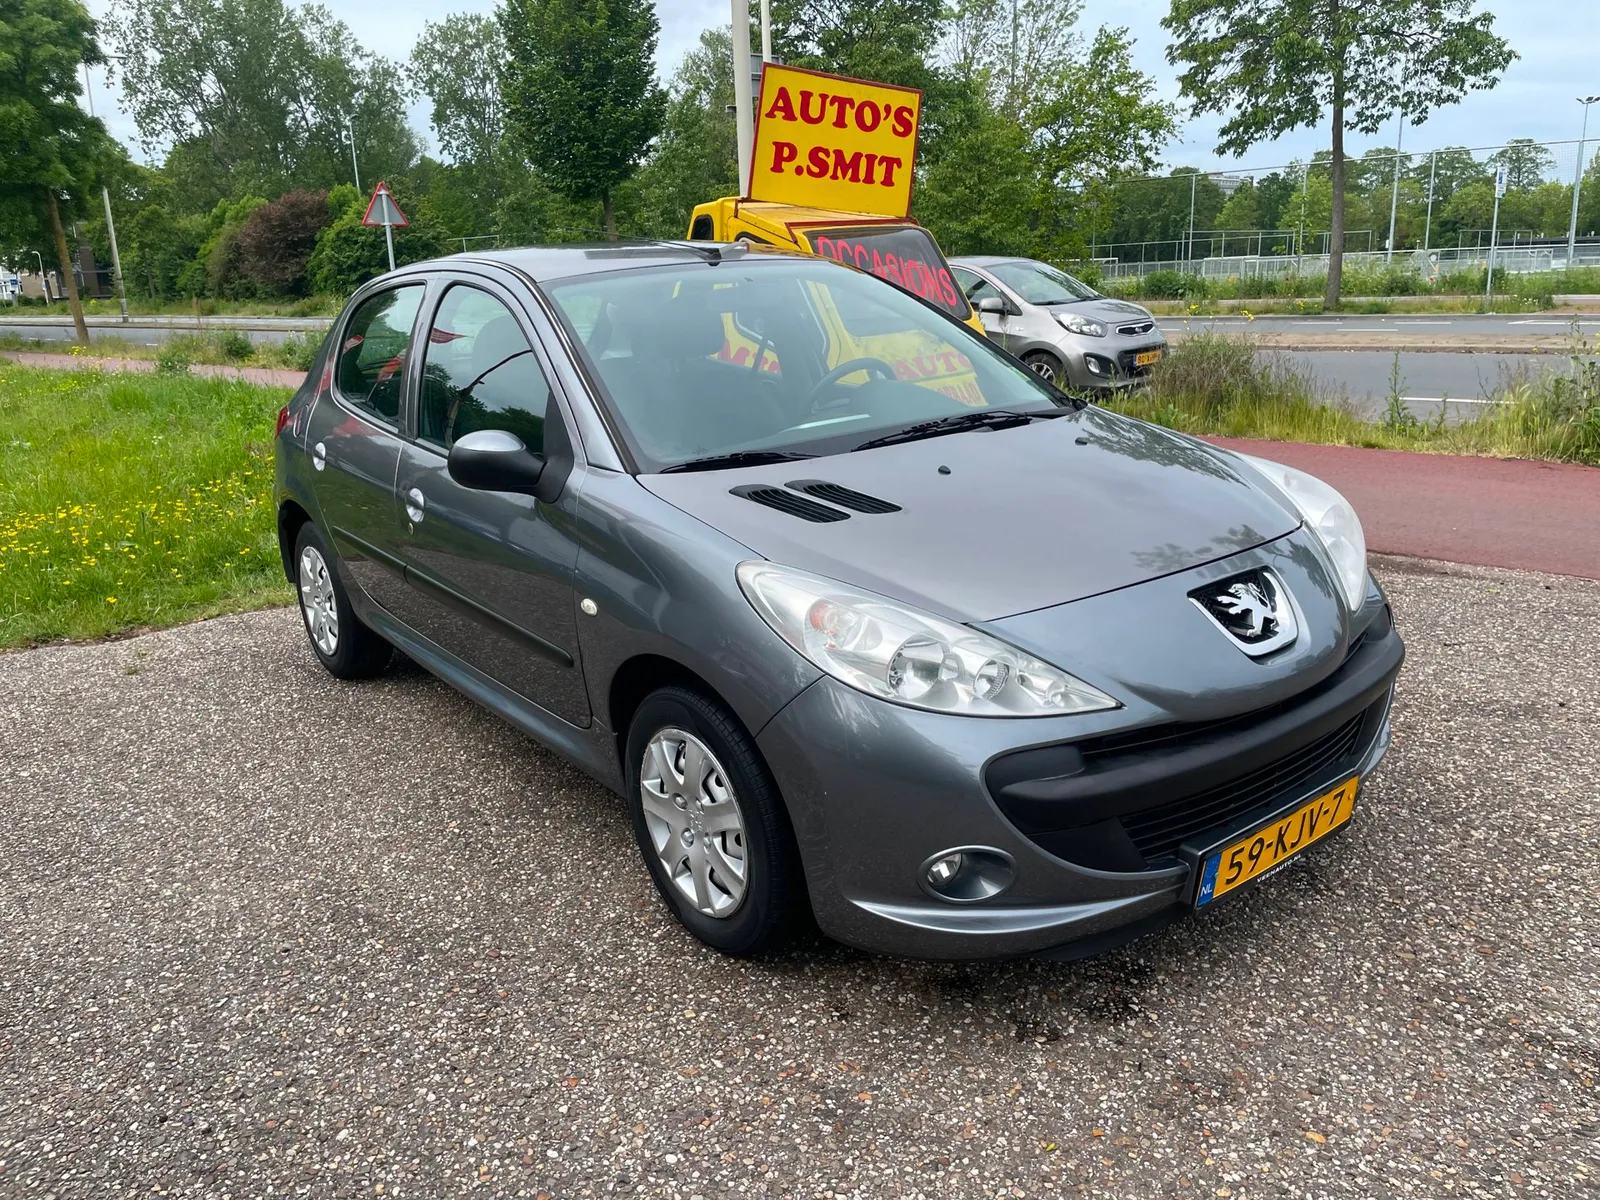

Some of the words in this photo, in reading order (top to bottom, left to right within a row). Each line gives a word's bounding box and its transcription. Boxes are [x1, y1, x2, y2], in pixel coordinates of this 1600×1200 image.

[765, 86, 914, 138] AUTO'S
[769, 141, 903, 187] P.SMIT
[1225, 788, 1346, 886] 59-KJV-7
[1200, 883, 1212, 897] NL
